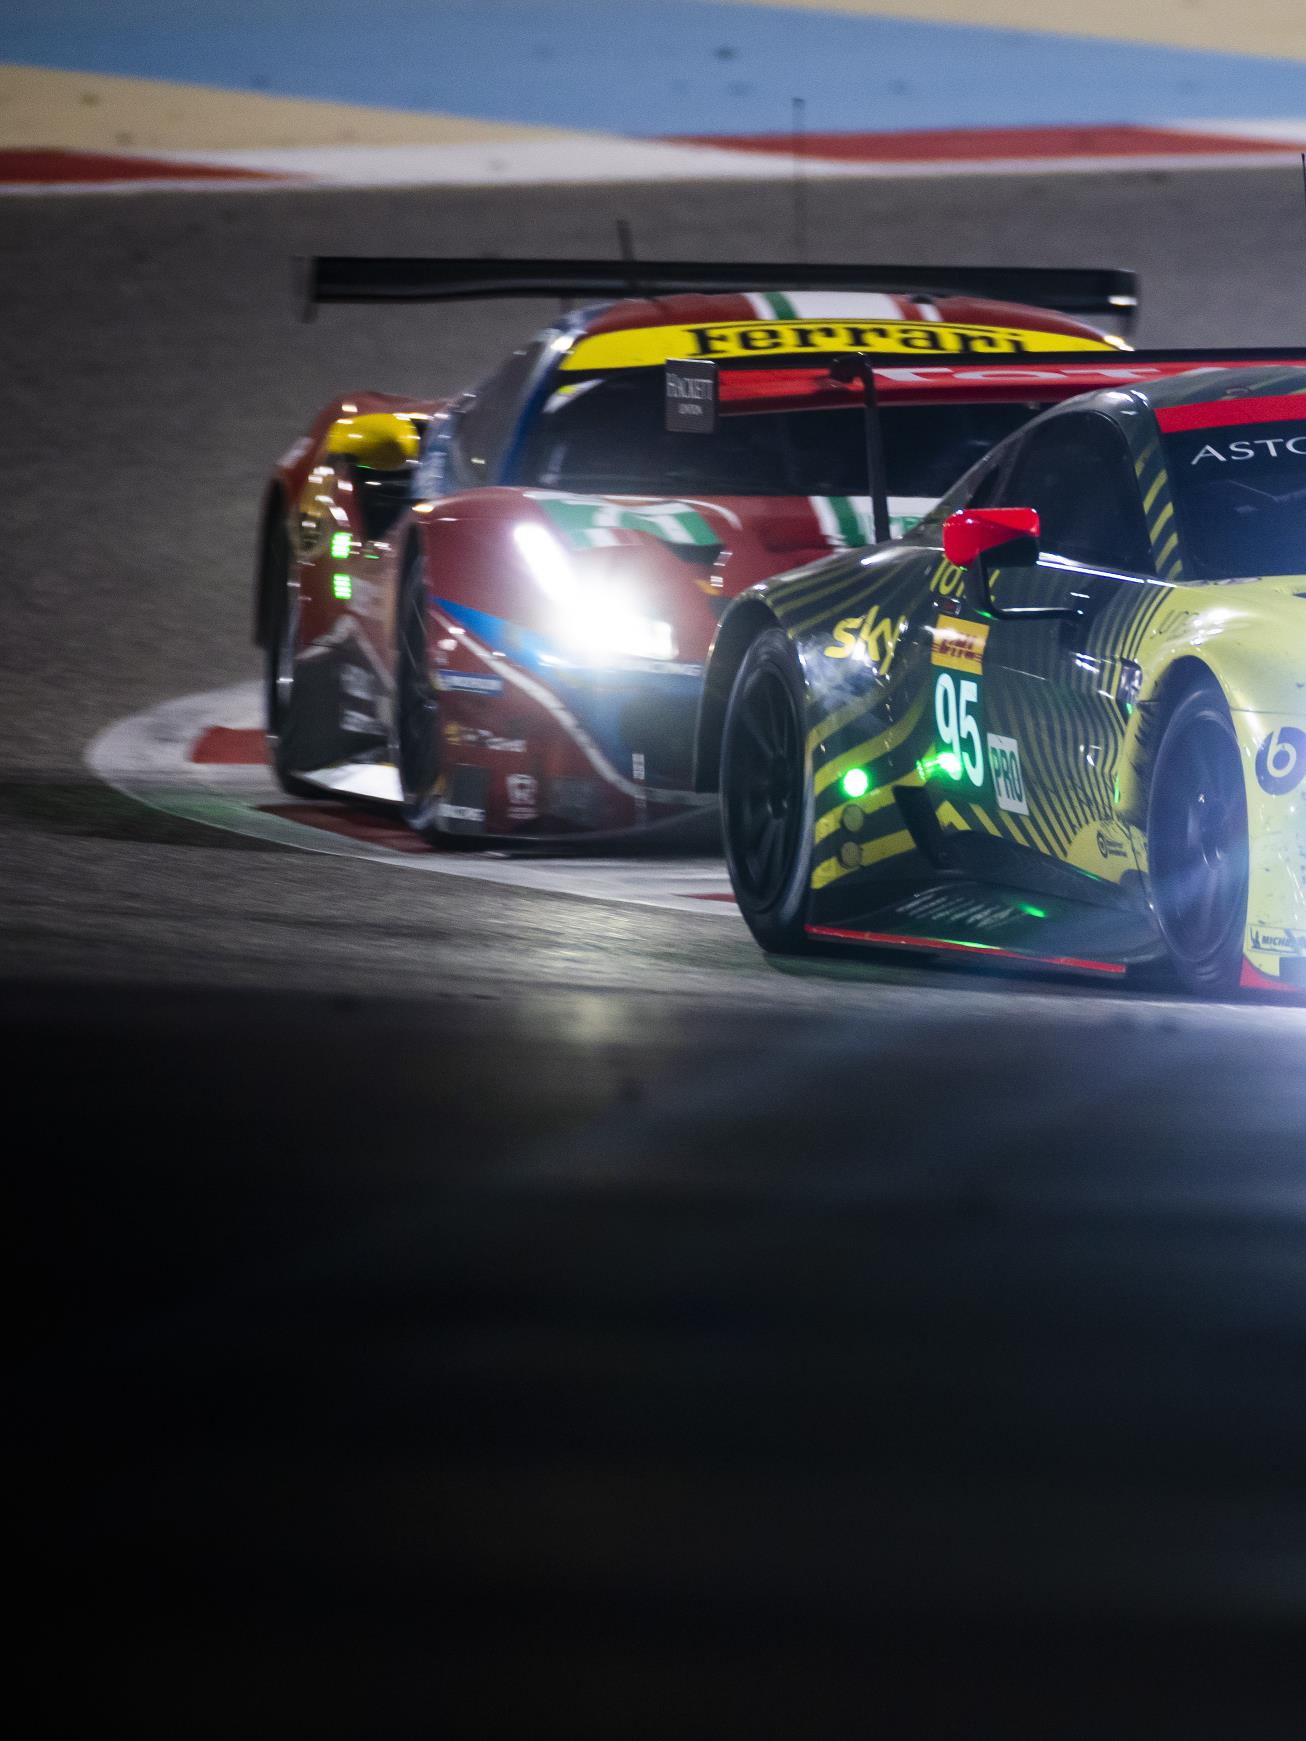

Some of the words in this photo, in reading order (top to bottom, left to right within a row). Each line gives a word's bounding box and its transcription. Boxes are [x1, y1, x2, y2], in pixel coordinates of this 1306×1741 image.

[685, 323, 1029, 356] Ferrari
[872, 366, 1230, 384] TOT
[824, 605, 906, 676] sky
[934, 672, 985, 788] 95
[989, 745, 1024, 803] PRO
